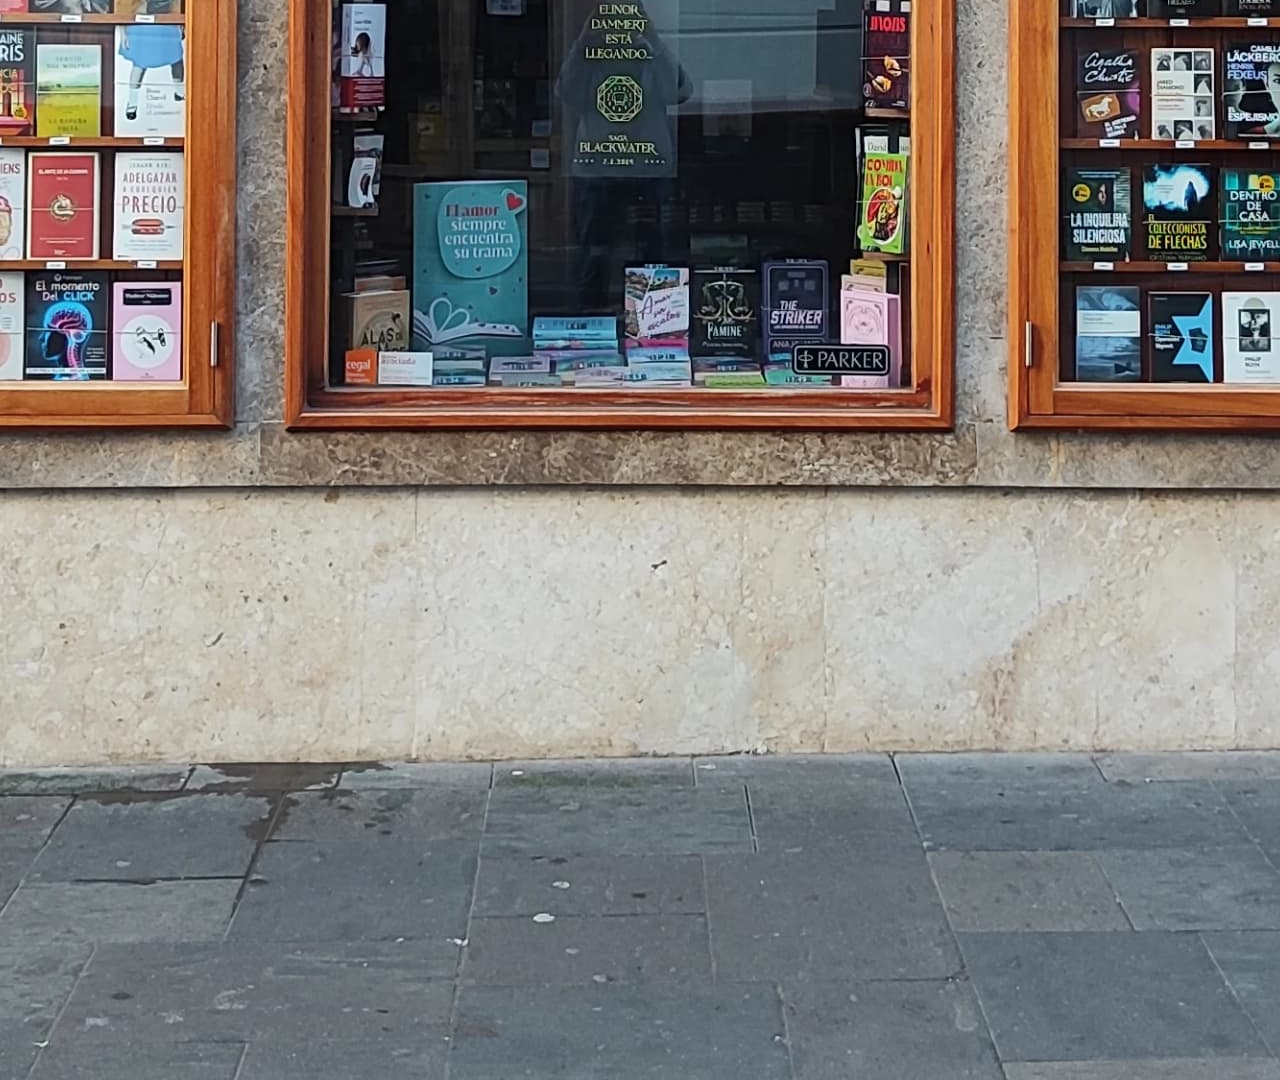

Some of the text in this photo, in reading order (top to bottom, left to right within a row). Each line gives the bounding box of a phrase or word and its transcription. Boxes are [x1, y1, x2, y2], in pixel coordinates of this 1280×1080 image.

[599, 4, 641, 18] ELINOR
[591, 19, 648, 32] DAMMERT
[1227, 71, 1267, 80] FEXEUS
[1228, 113, 1279, 122] ESPEJISMO
[579, 142, 659, 155] BLACKWATER
[123, 173, 177, 183] ADELGAZAR
[1230, 191, 1277, 201] DENTRO
[122, 196, 177, 214] PRECIO
[1246, 201, 1262, 210] DE
[462, 206, 500, 218] amor
[1239, 210, 1270, 221] CASA
[451, 218, 506, 233] siempre
[1148, 223, 1207, 234] COLECCIONISTA
[444, 232, 514, 245] encuentra
[1073, 229, 1126, 244] SILENCIOSA
[1148, 236, 1207, 249] DE FLECHAS
[1228, 239, 1280, 249] LISA JEWELL
[454, 247, 513, 259] su trama
[35, 281, 99, 291] El momento
[42, 292, 95, 301] Del CLICK
[780, 300, 798, 311] THE
[771, 310, 822, 324] STRIKER
[707, 322, 743, 339] FAMINE
[361, 328, 394, 346] ALAS
[346, 359, 370, 371] cegal
[818, 351, 883, 368] PARKER
